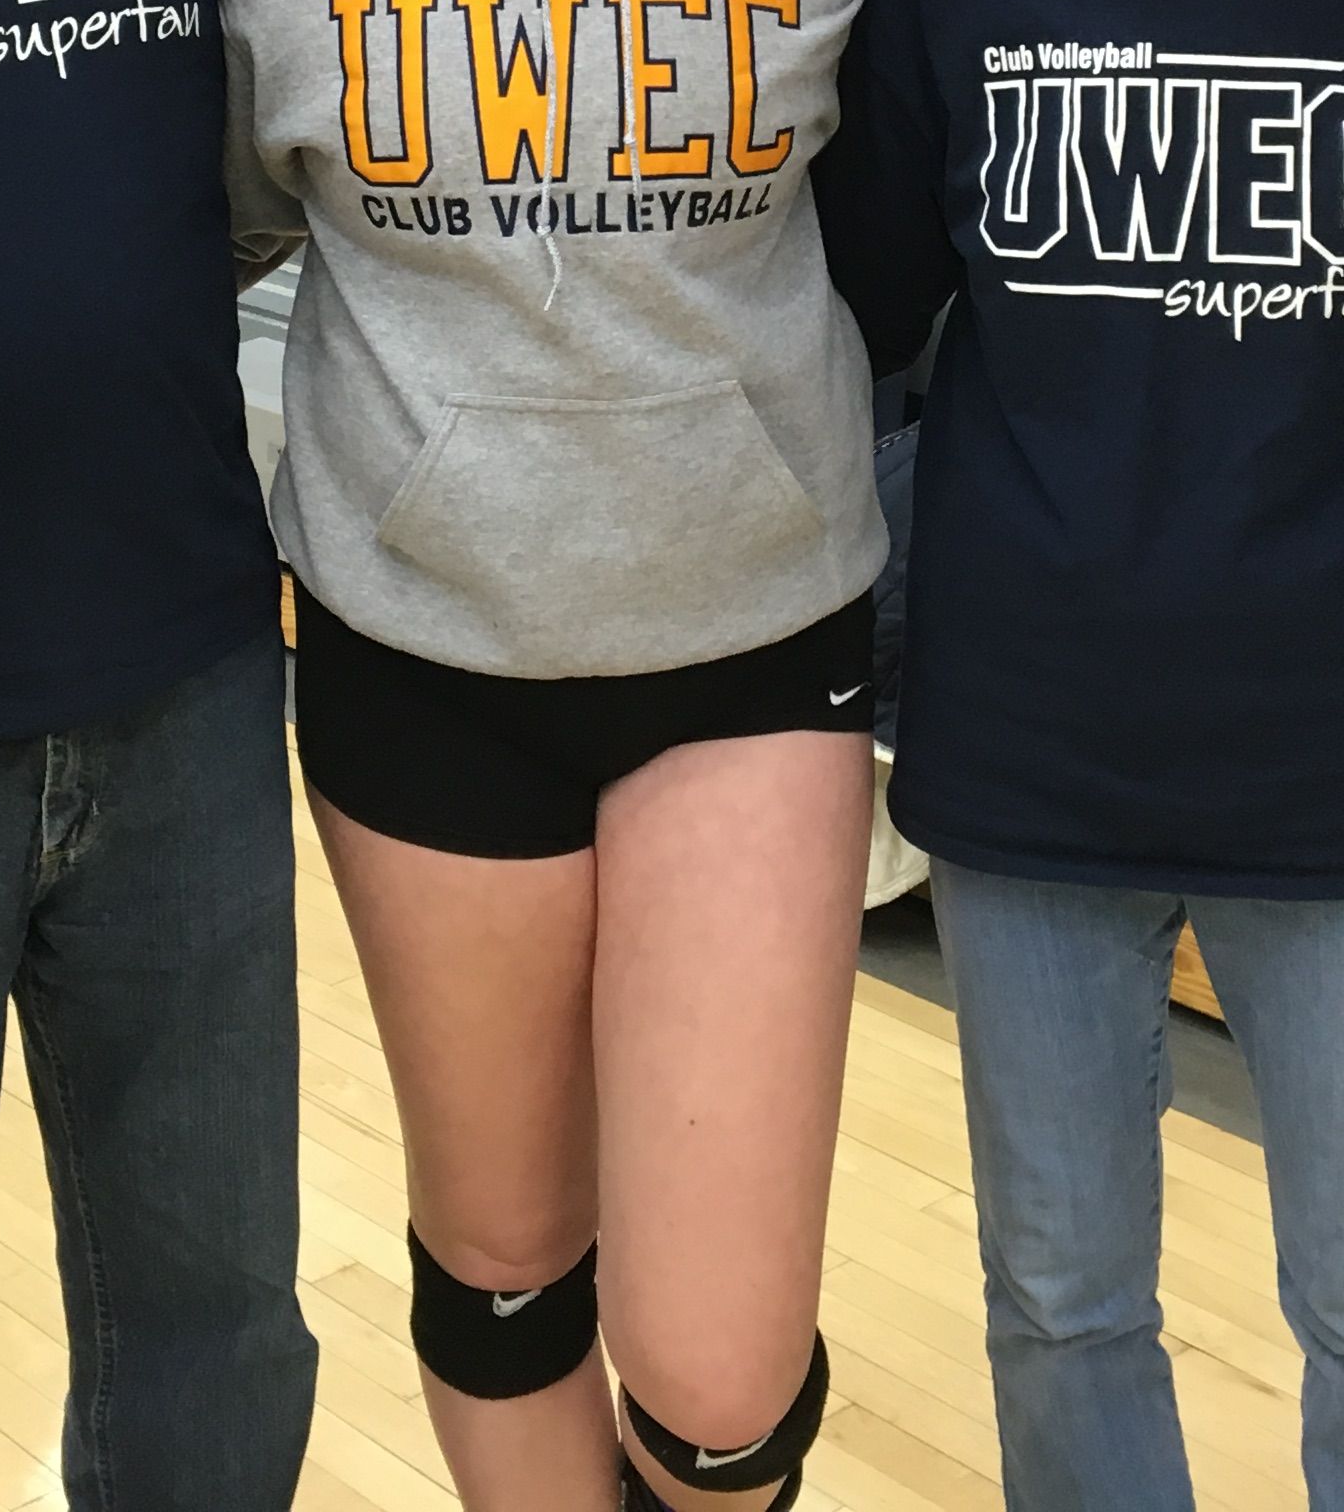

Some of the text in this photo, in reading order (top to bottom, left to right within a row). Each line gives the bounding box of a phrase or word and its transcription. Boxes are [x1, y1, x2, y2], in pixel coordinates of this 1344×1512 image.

[984, 42, 1153, 75] Club Volleyball
[362, 182, 772, 238] CLUB VOLLEYBALL
